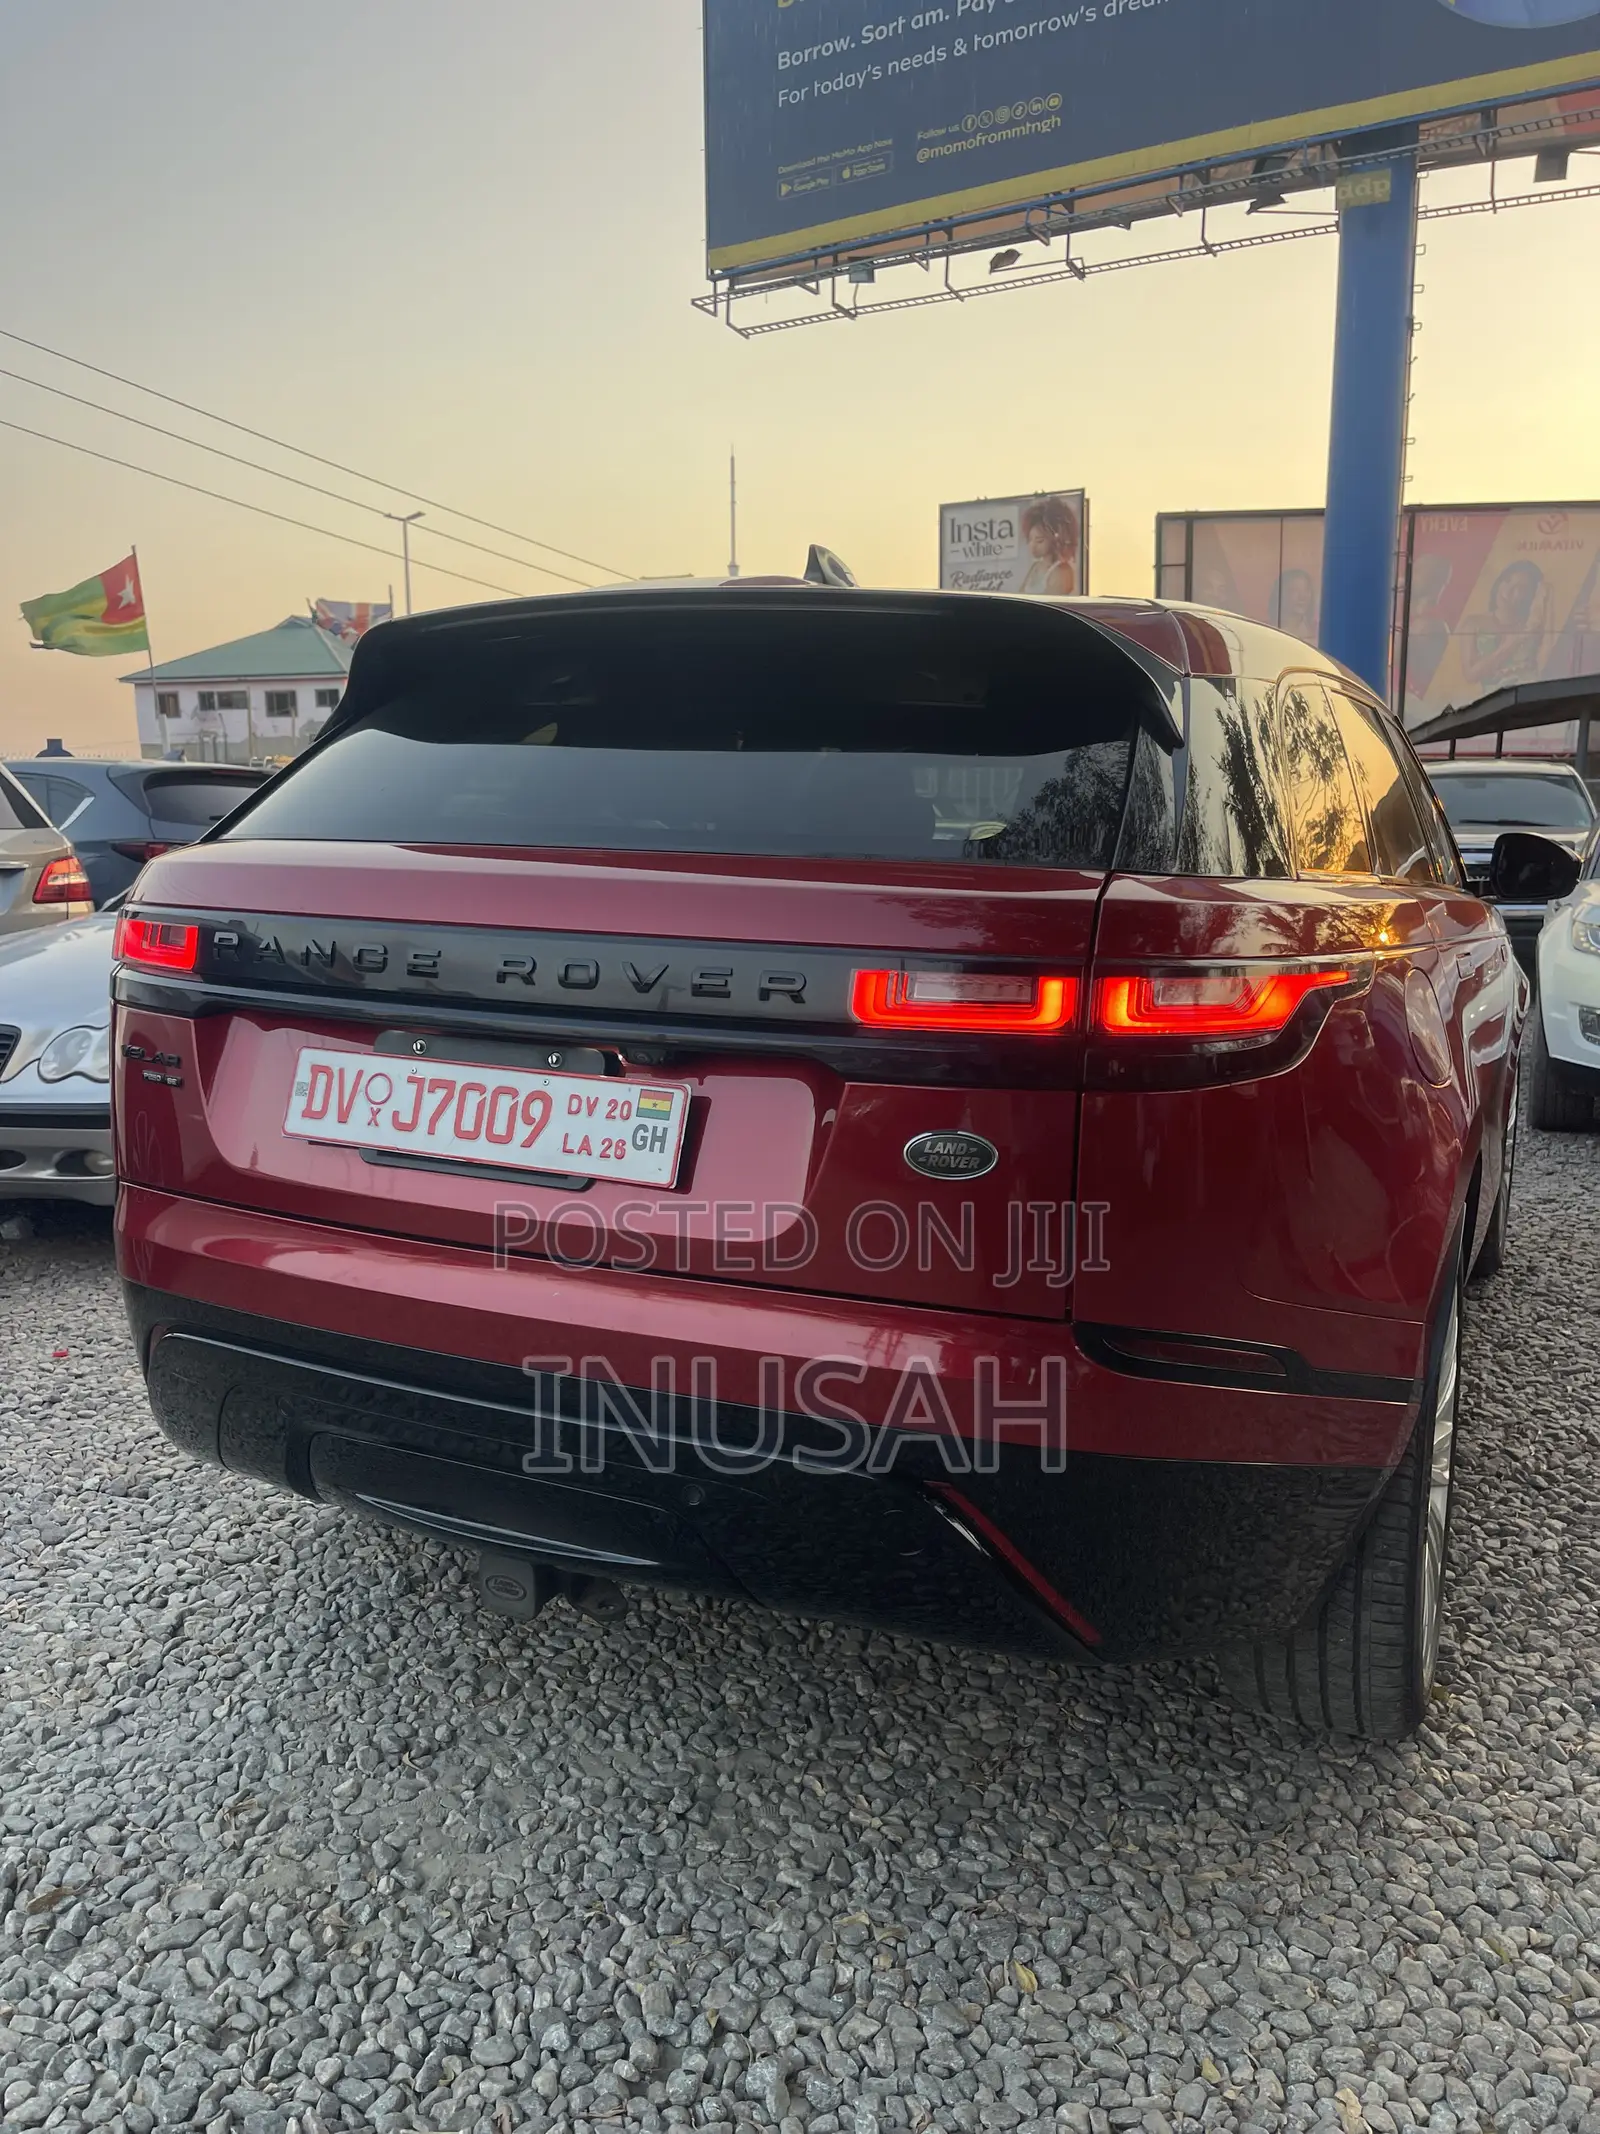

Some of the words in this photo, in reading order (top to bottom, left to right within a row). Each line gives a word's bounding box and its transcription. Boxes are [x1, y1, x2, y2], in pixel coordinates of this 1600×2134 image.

[777, 36, 856, 70] Borrow.
[861, 16, 906, 45] Sort
[911, 8, 950, 30] am.
[957, 0, 995, 17] Pay
[778, 87, 809, 108] For
[814, 64, 882, 97] today's
[888, 45, 947, 75] needs
[953, 38, 967, 56] &
[973, 6, 1097, 51] tomorrow's
[1103, 0, 1168, 17] drea
[916, 115, 1061, 163] @momofrommtngh
[917, 126, 946, 140] Follow
[948, 123, 960, 132] us
[950, 517, 1014, 544] Insta
[963, 541, 1003, 558] white
[950, 568, 1014, 588] Radiance
[212, 930, 442, 980] RANGE
[497, 953, 807, 1005] ROVER
[301, 1064, 364, 1123] DV
[391, 1075, 553, 1149] J7009
[566, 1093, 599, 1118] DV
[604, 1098, 632, 1121] 20
[562, 1132, 592, 1157] LA
[599, 1137, 627, 1161] 26
[631, 1123, 669, 1154] GH
[924, 1141, 967, 1155] LAND
[927, 1155, 980, 1169] ROVER
